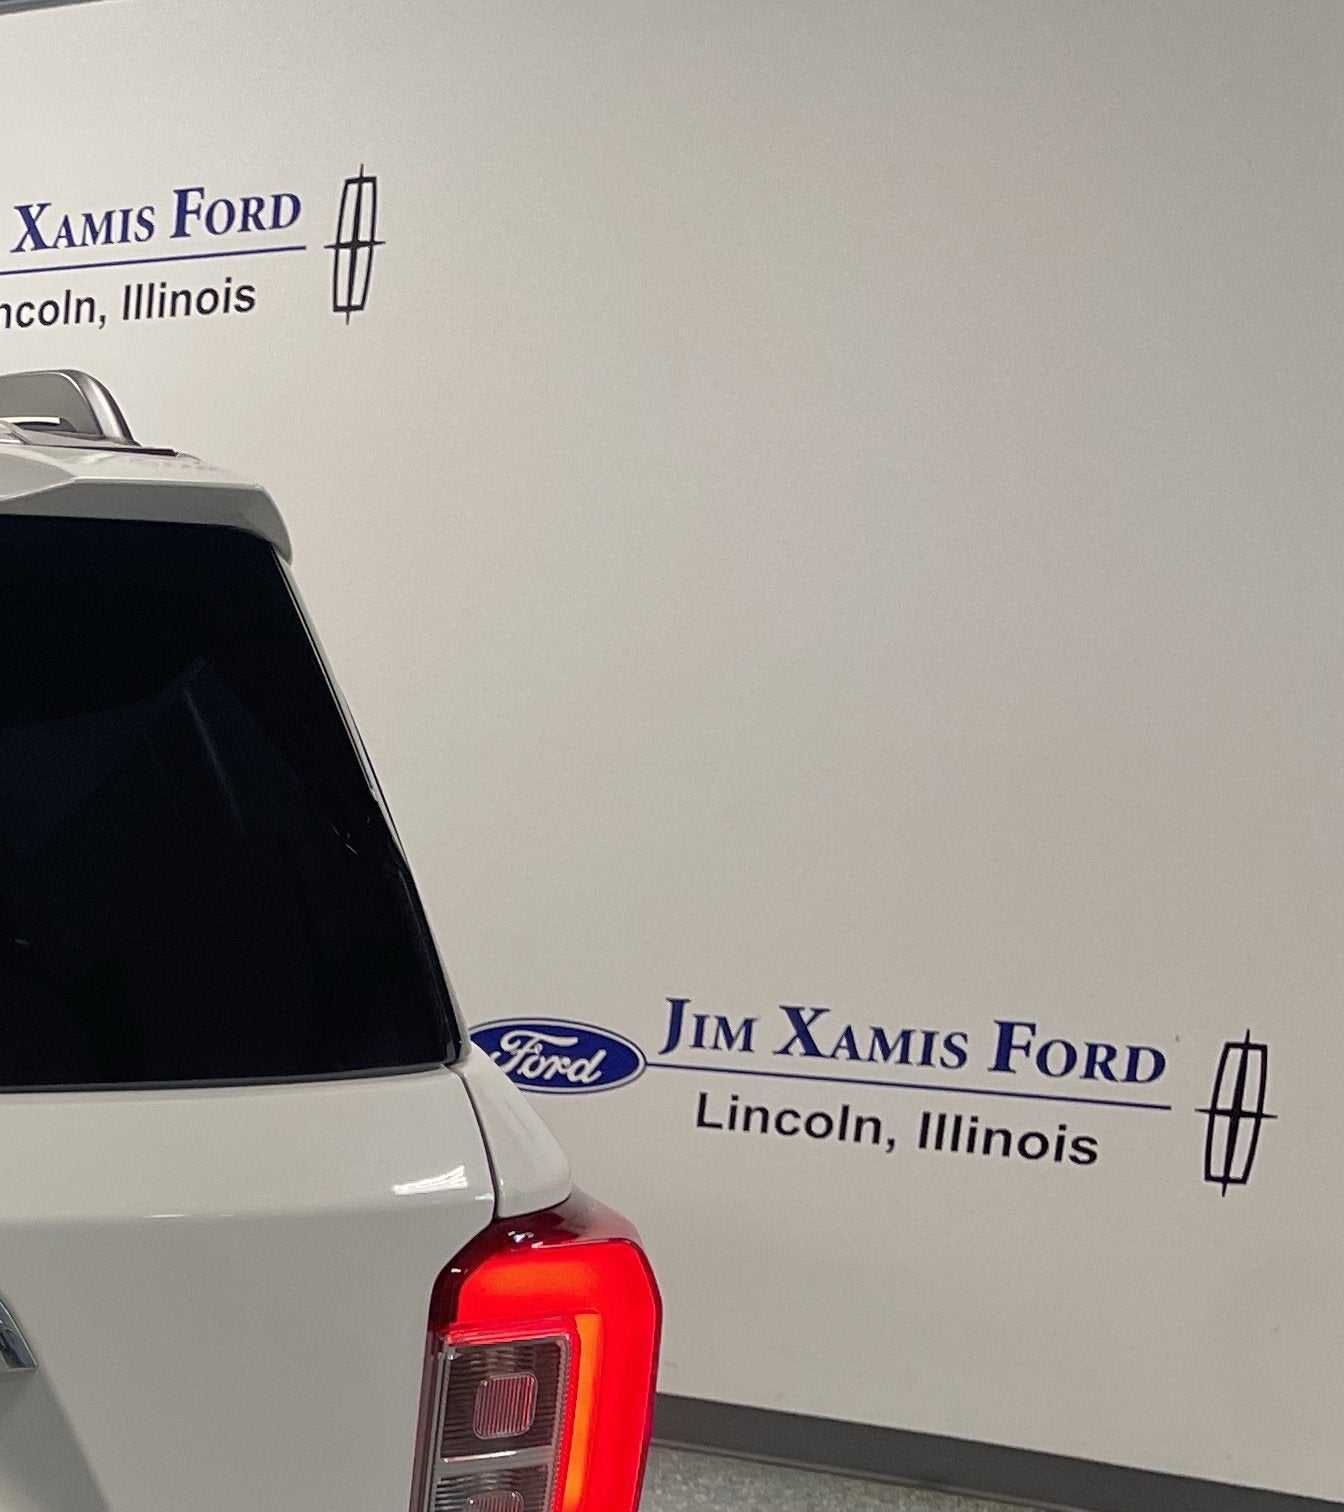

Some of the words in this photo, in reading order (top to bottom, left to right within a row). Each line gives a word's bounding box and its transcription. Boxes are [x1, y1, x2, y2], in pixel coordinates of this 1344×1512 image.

[122, 278, 257, 320] Illinois
[491, 1029, 607, 1084] Ford
[696, 1091, 896, 1154] Lincoln,
[918, 1111, 1099, 1166] Illinois
